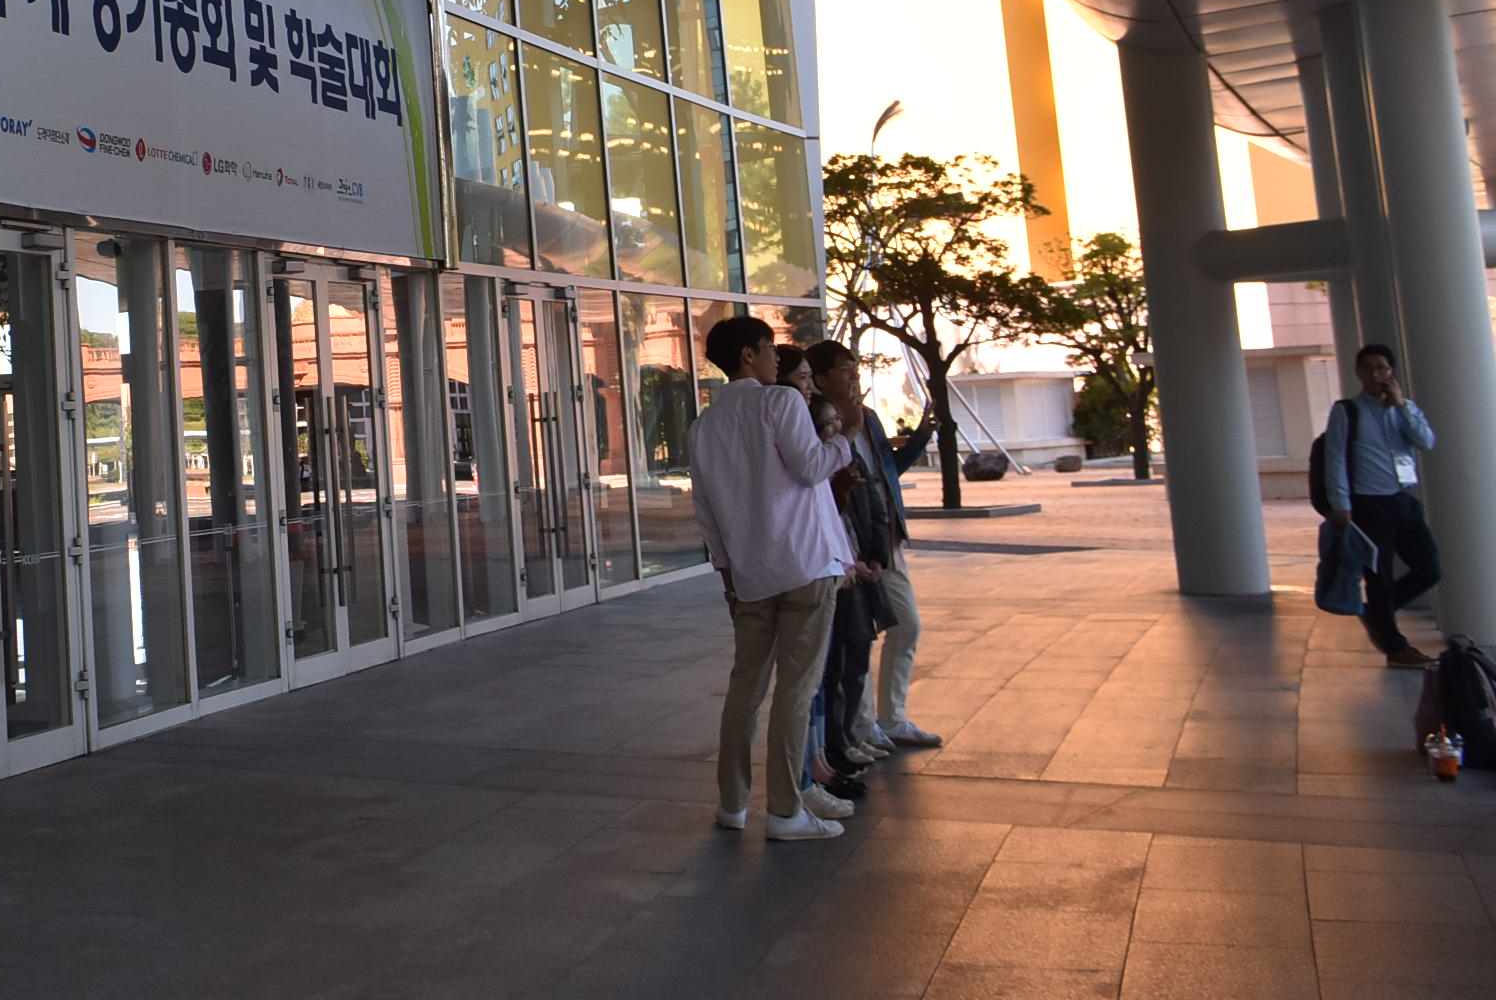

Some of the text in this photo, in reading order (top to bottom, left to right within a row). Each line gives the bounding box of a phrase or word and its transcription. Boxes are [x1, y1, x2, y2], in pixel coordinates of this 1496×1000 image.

[285, 7, 402, 127] 학술대회
[99, 133, 131, 148] DONGWOO
[147, 147, 168, 159] LOTTE
[213, 158, 238, 176] LG화학
